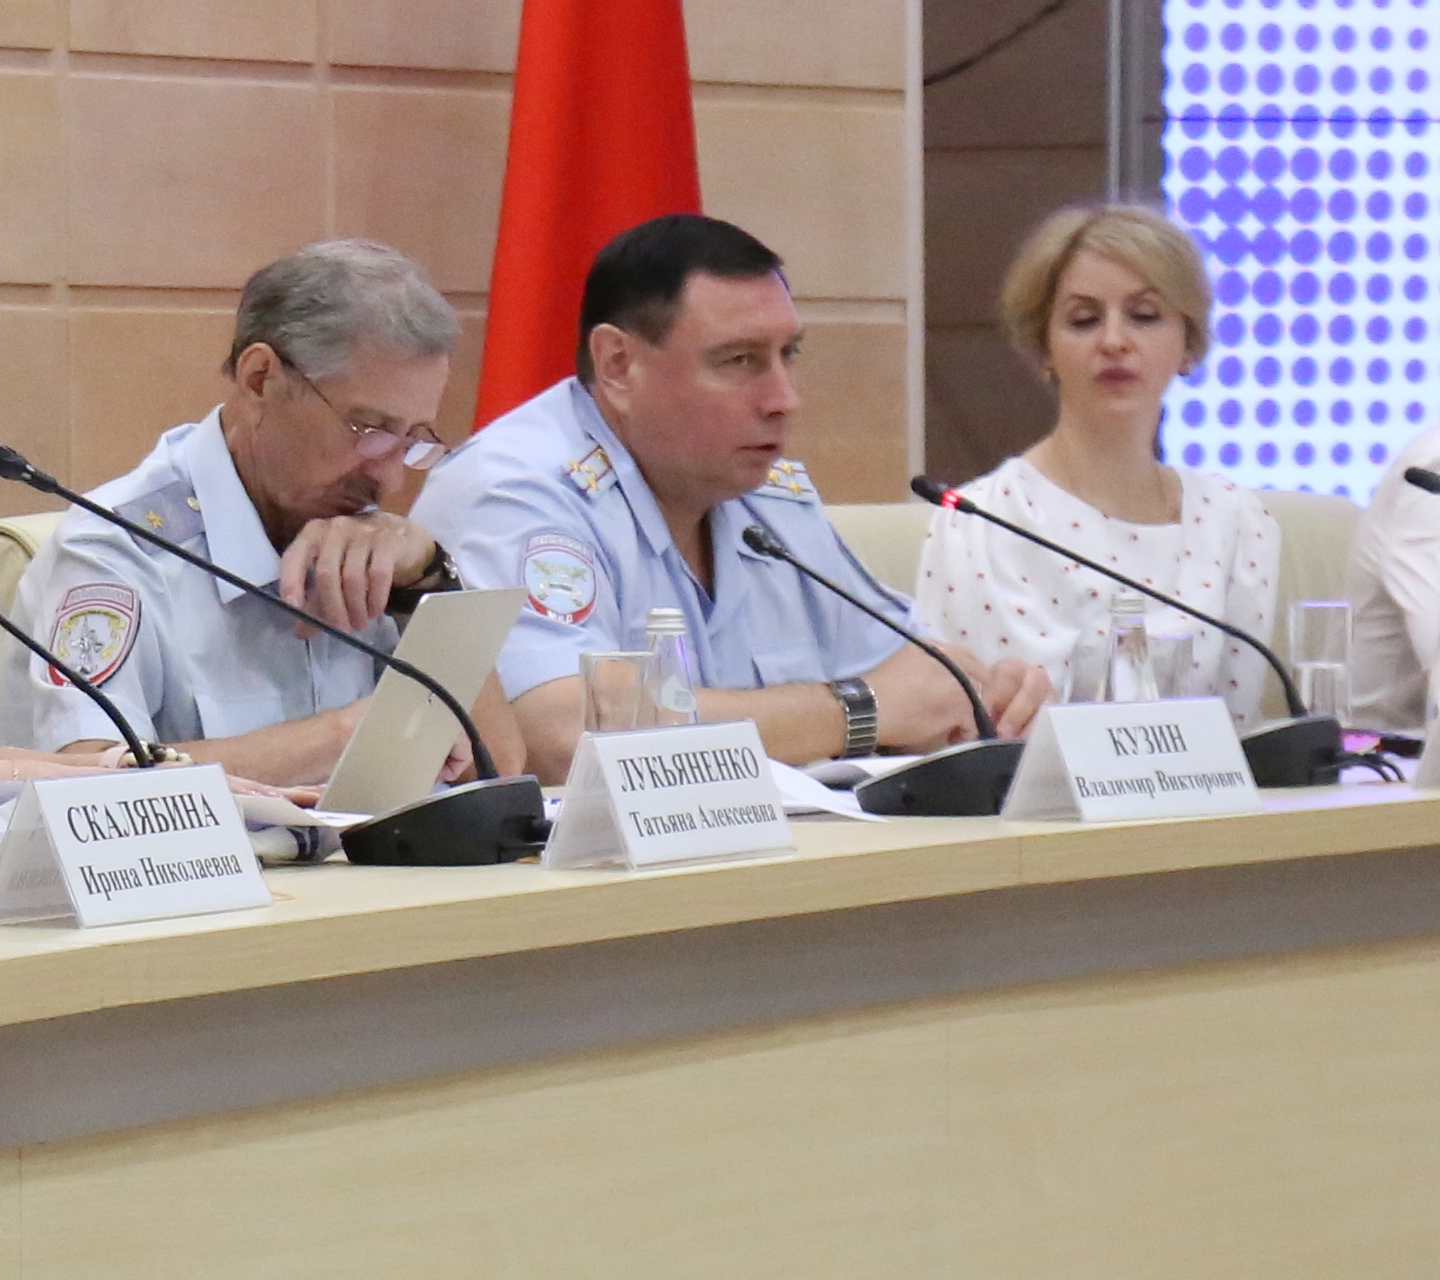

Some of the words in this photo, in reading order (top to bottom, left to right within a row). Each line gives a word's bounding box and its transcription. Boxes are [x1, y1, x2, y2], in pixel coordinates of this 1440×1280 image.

[1107, 724, 1188, 756] КУЗИН
[617, 746, 760, 793] ЛУКЬЯНЕНКО
[1075, 776, 1155, 798] Владимир
[1154, 770, 1245, 795] Викторович
[67, 792, 221, 844] СКАЛЯБИНА
[629, 810, 698, 838] Татьяна
[698, 804, 777, 830] Алексеевна
[79, 865, 143, 901] Ирина
[139, 854, 243, 887] Николаевна
